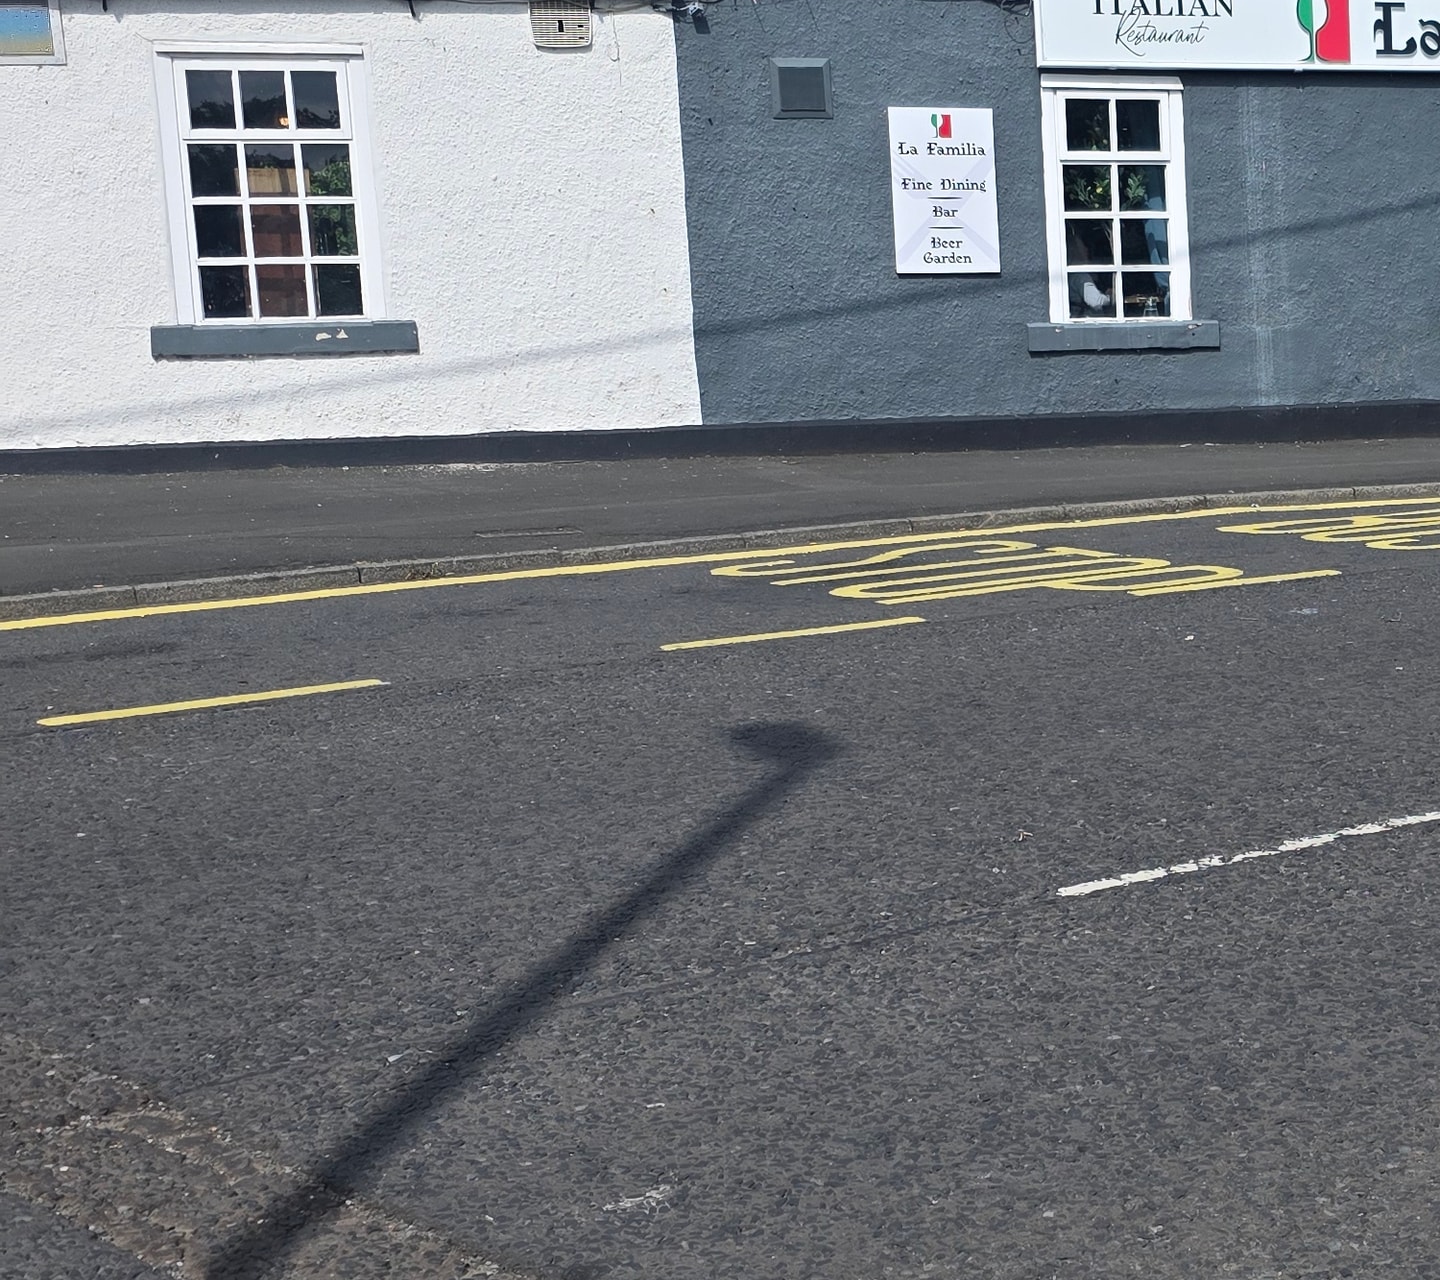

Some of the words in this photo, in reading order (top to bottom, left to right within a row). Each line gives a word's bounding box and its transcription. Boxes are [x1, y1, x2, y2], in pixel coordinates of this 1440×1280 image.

[1113, 7, 1209, 56] Restaurant
[897, 141, 918, 155] La
[927, 142, 986, 156] Familia
[901, 177, 933, 191] Fine
[940, 178, 987, 193] Dining
[932, 205, 958, 218] Bar
[930, 237, 963, 249] Beer
[923, 252, 973, 264] Garden
